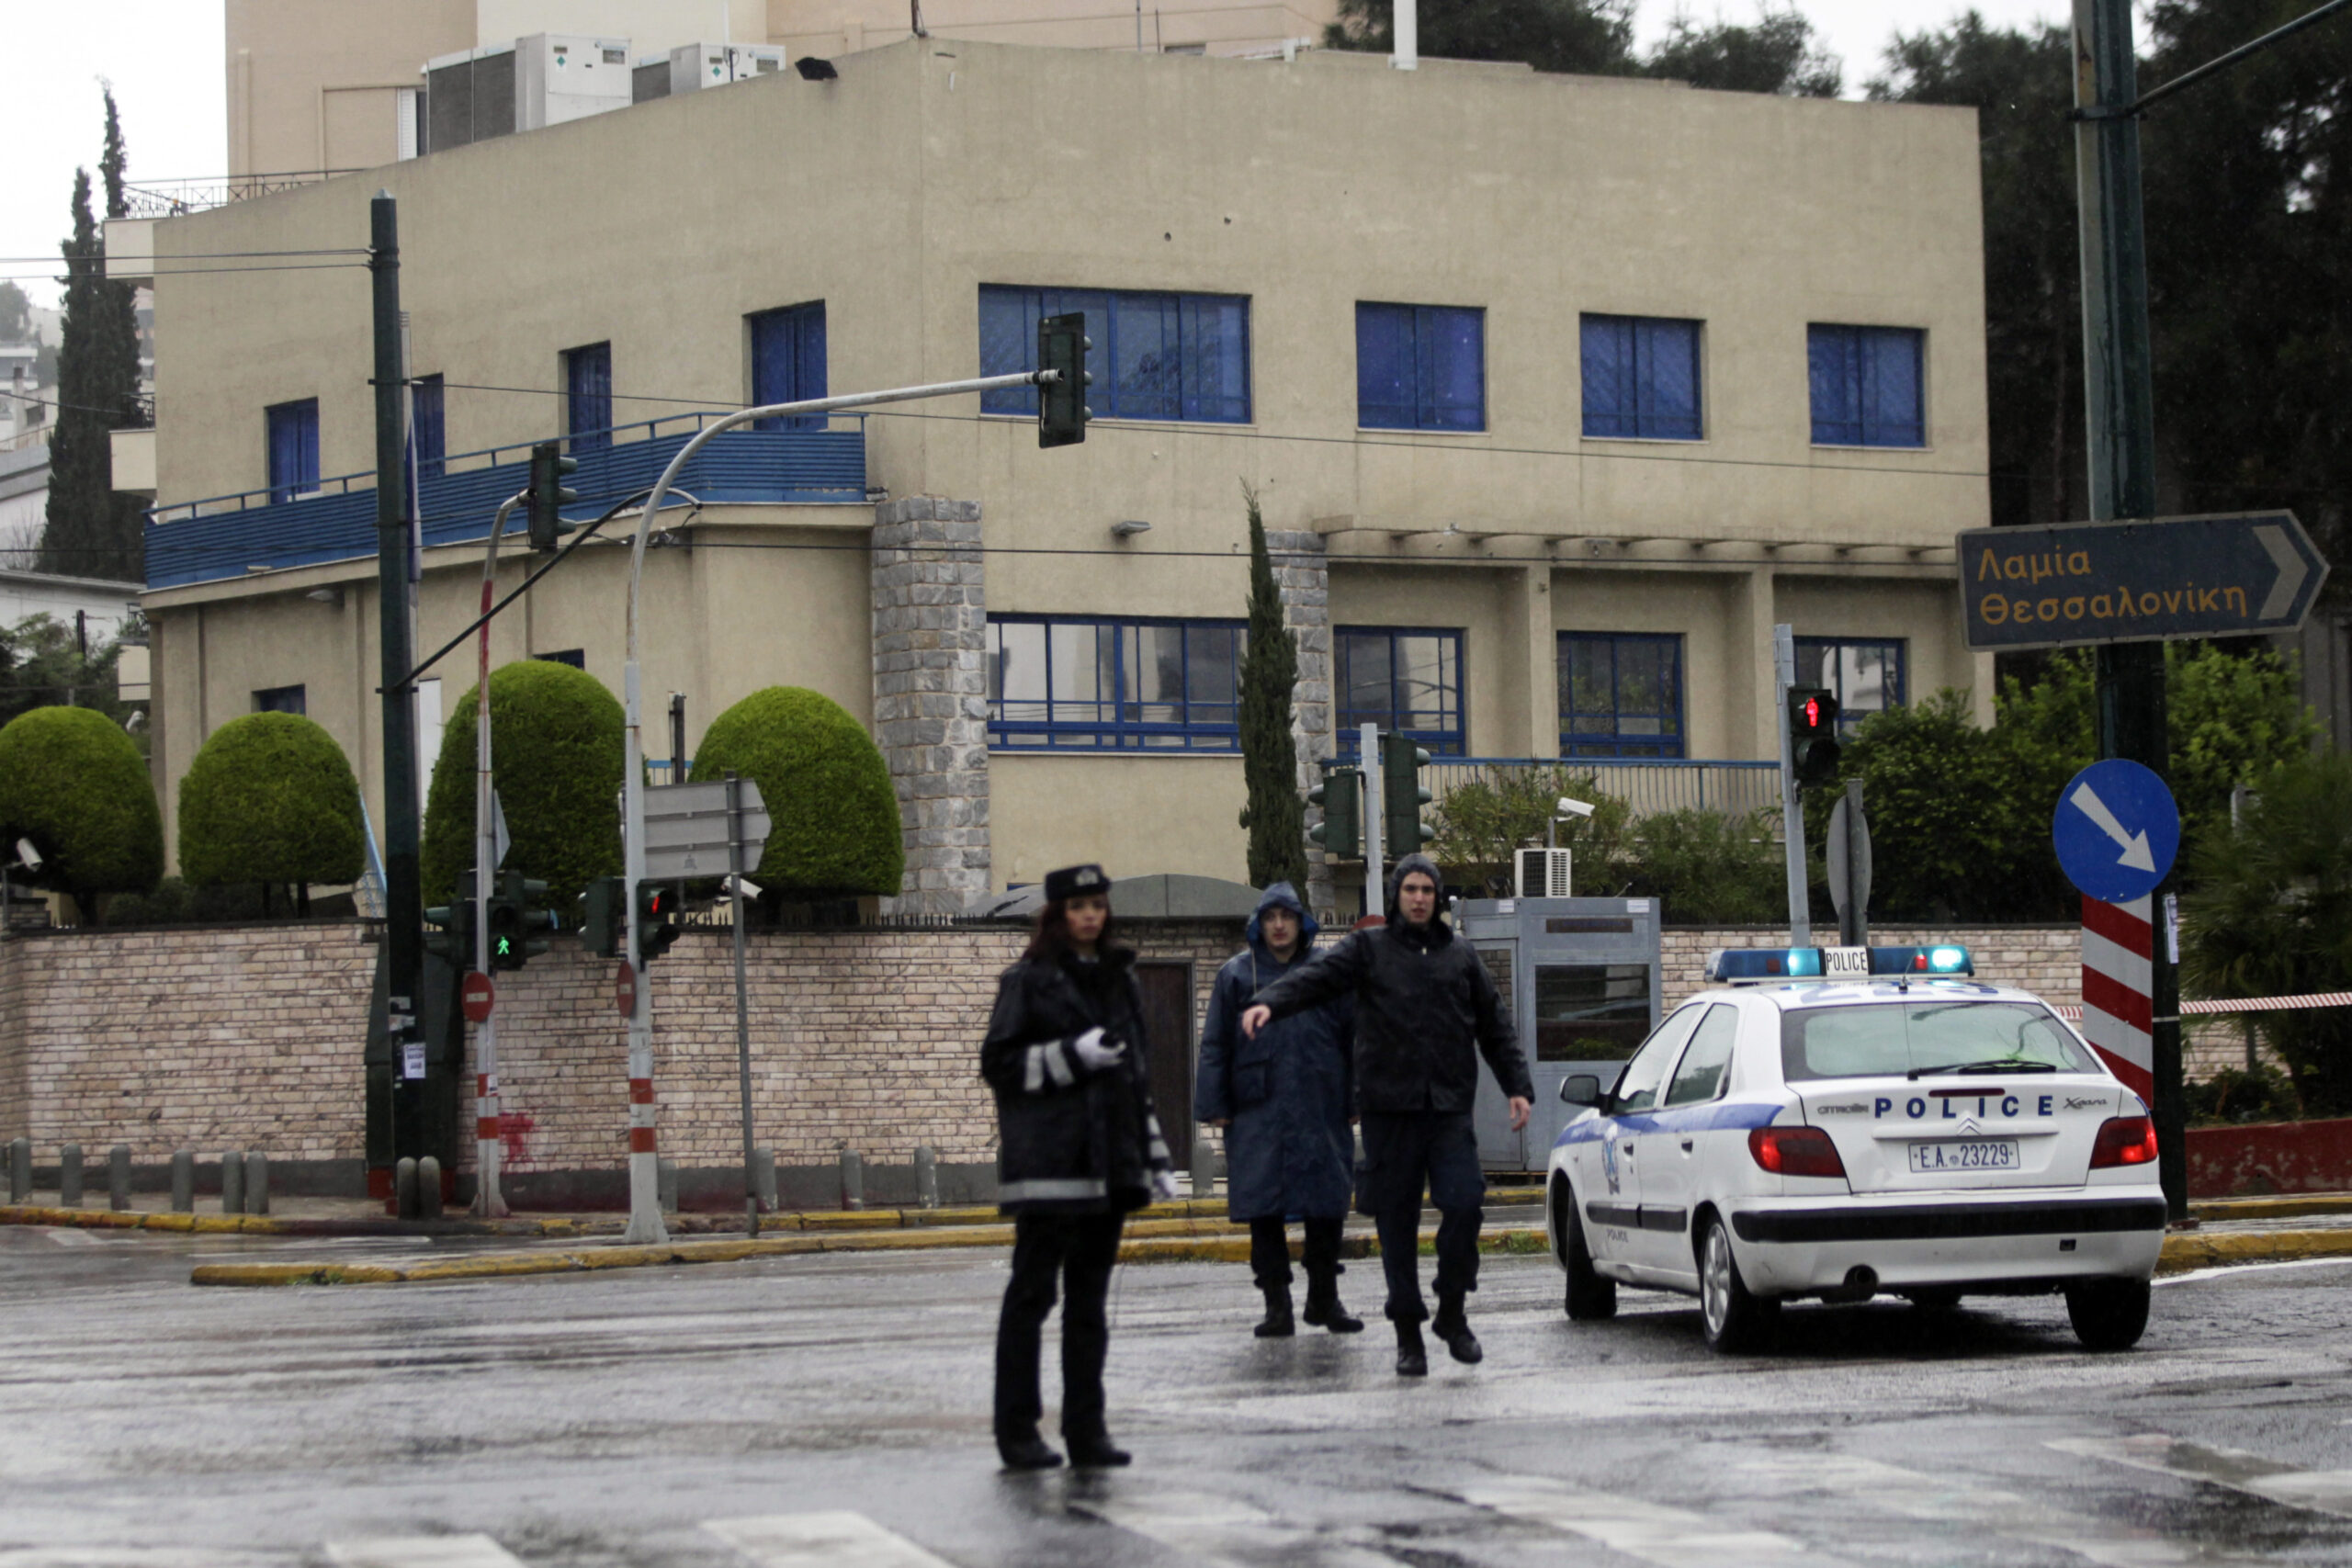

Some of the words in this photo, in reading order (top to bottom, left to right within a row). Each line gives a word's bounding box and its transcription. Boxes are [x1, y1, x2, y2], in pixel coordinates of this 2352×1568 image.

[1977, 544, 2092, 585] Λαμία
[1979, 581, 2248, 626] Θεσσαλονίκη
[1825, 951, 1868, 971] POLICE
[1874, 1095, 2054, 1119] POLICE
[1960, 1143, 2010, 1168] 23229
